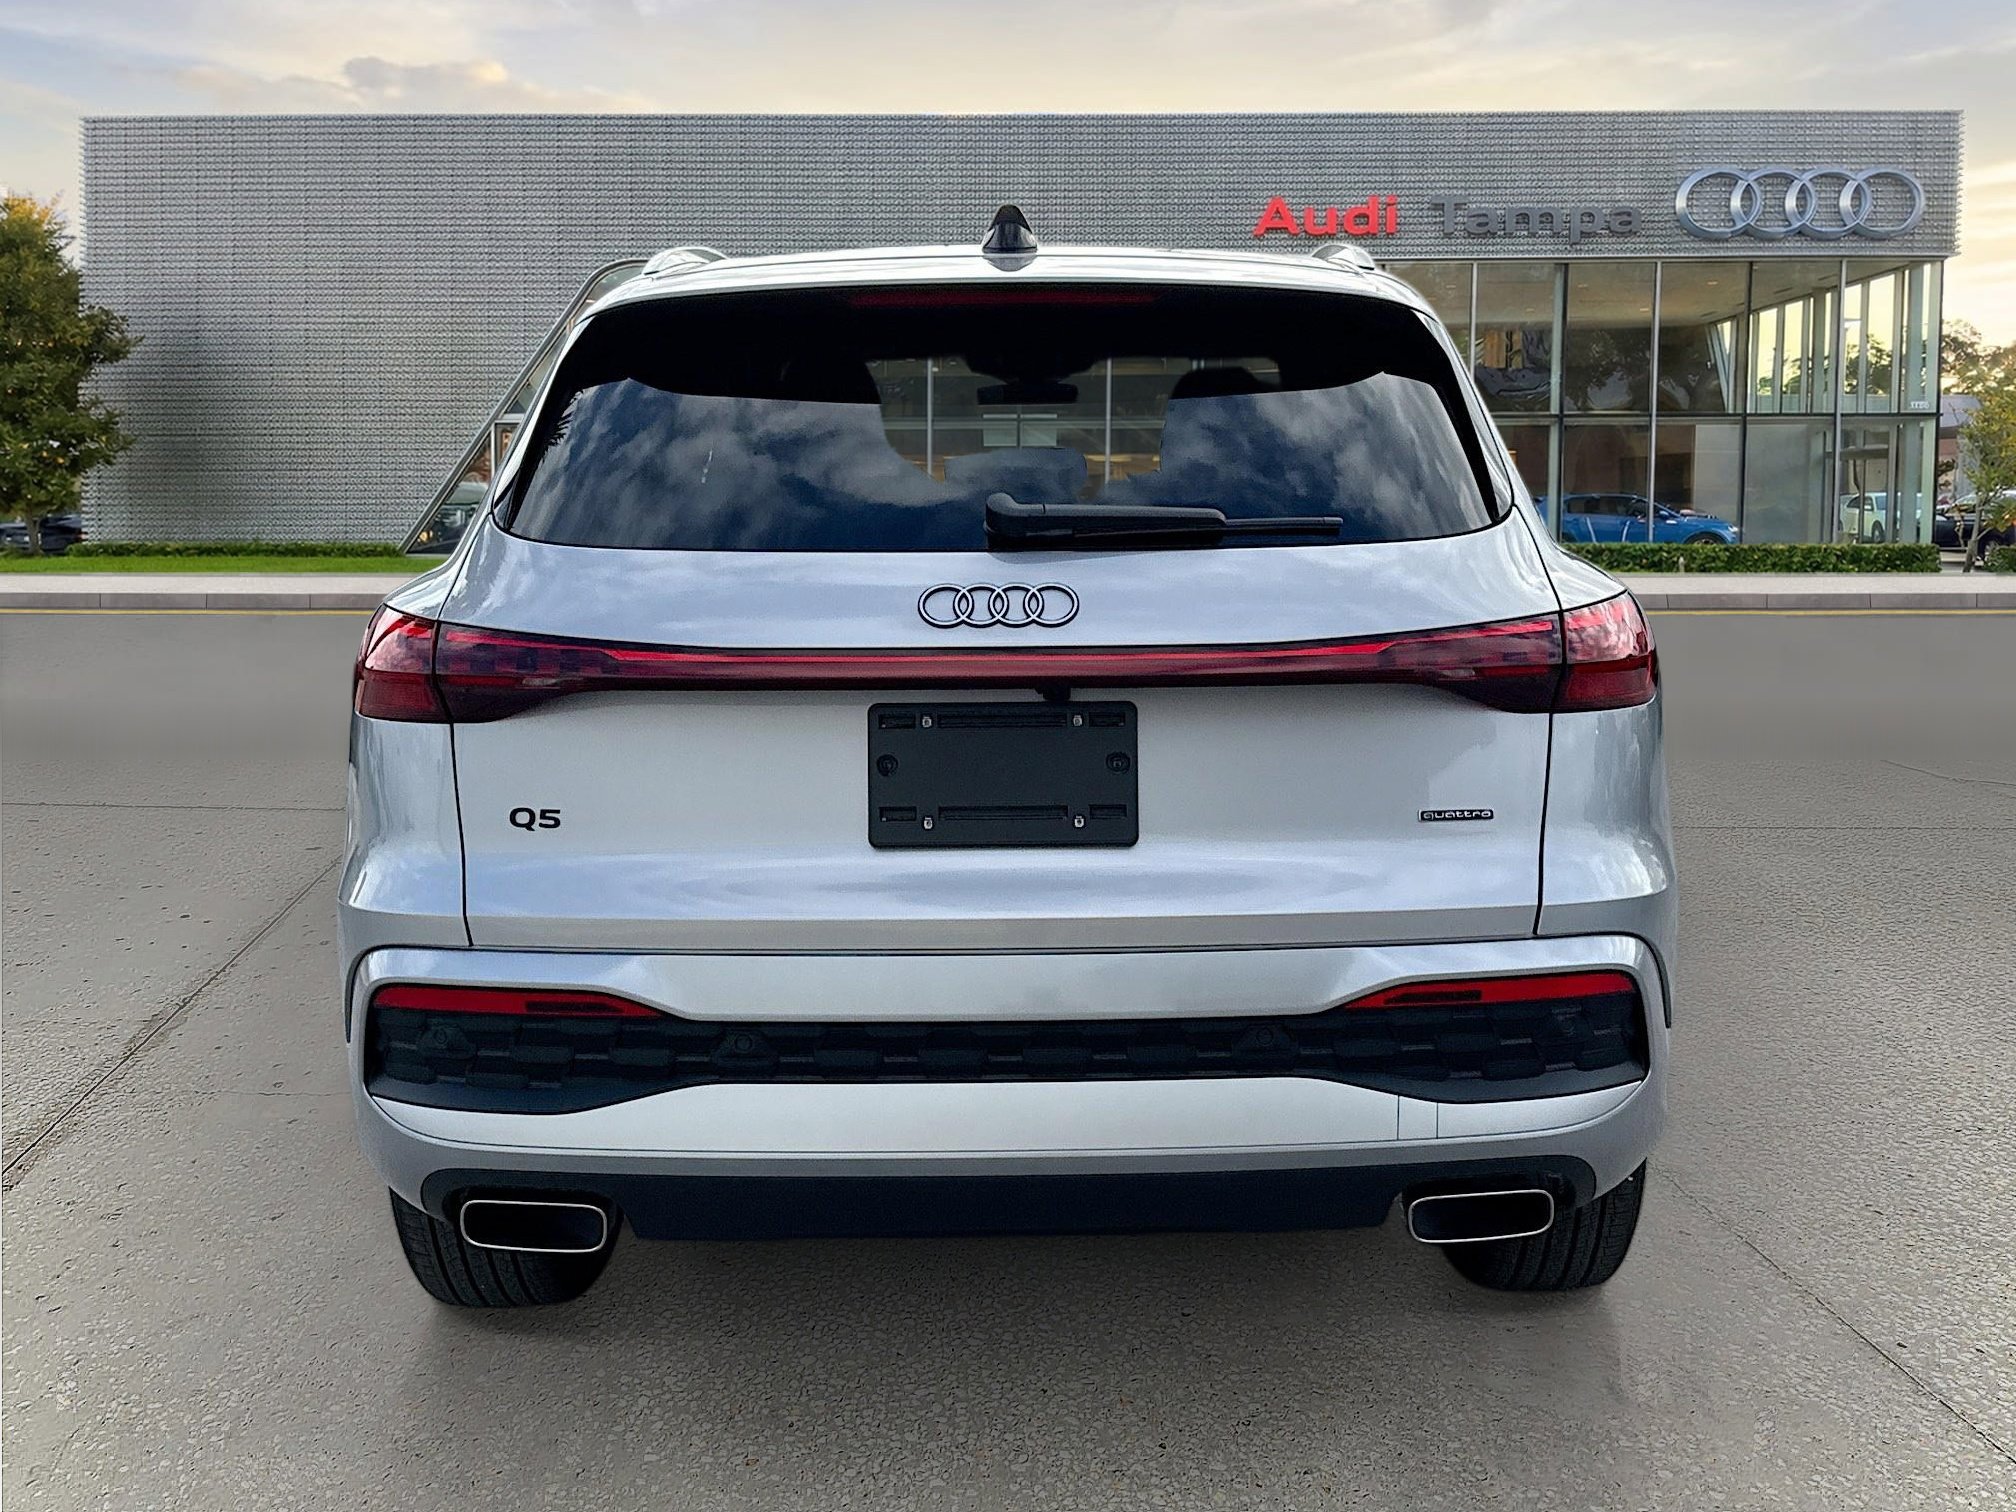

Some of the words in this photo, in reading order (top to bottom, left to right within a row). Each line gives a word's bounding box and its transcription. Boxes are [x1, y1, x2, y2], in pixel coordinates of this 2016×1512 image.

[1253, 194, 1397, 236] Audi
[1431, 195, 1641, 246] Tampa
[509, 807, 561, 831] Q5
[1422, 810, 1492, 820] quattro
